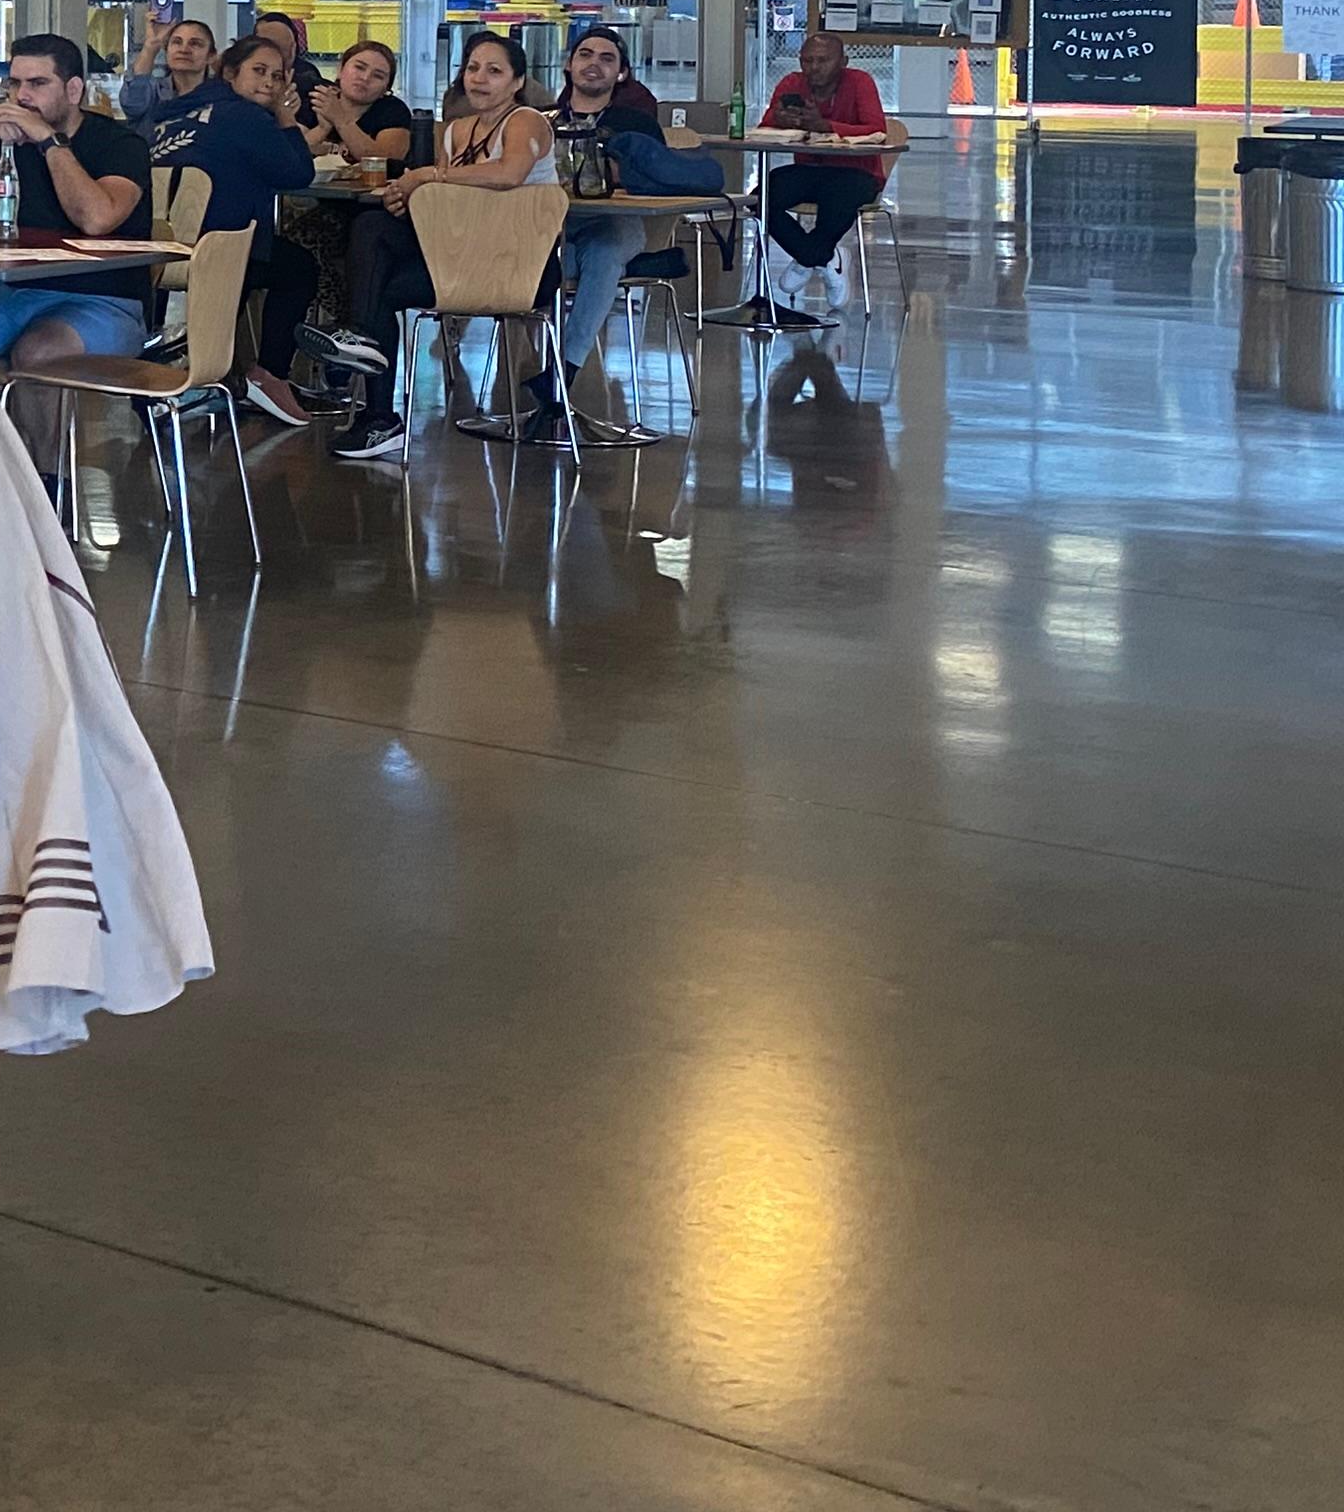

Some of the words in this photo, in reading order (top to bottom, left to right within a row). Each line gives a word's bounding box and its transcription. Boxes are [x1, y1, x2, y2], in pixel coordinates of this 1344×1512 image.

[1041, 12, 1108, 21] AUTHENTIC
[1111, 9, 1172, 18] GOODNESS
[1294, 5, 1341, 17] THANK
[1066, 27, 1137, 43] ALWAYS
[1052, 40, 1155, 61] FORWARD
